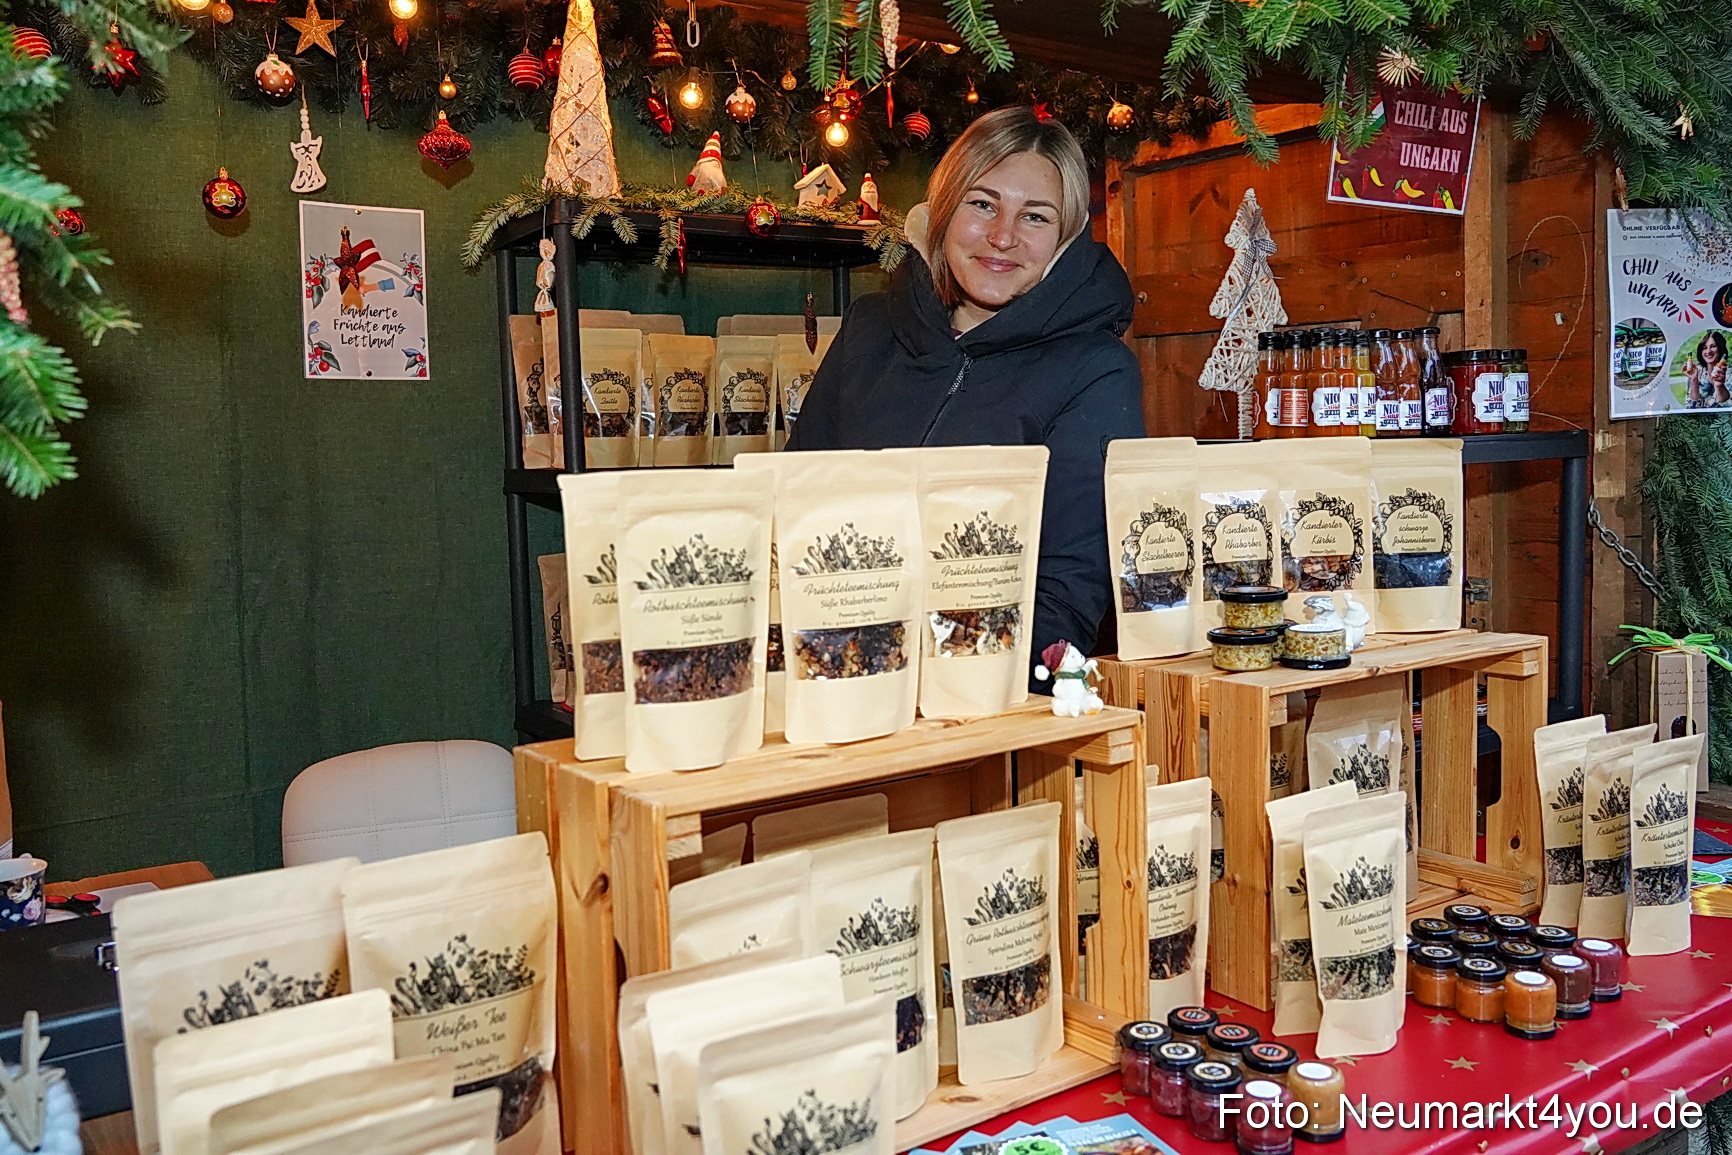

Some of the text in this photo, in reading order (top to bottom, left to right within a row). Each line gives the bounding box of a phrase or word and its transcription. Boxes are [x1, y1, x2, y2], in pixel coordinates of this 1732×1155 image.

[1394, 100, 1469, 135] CHILI AUS
[1400, 142, 1462, 174] UNGARN
[1623, 258, 1692, 292] CHILI AUS
[1628, 280, 1680, 318] UNGARN
[340, 303, 399, 320] Kandierte
[333, 319, 407, 335] Früchte aus
[341, 333, 396, 349] Lettland
[1397, 511, 1429, 521] Kandierte
[1221, 522, 1258, 535] Kandierte
[1300, 520, 1343, 531] Kandierter
[1398, 524, 1430, 533] schwarze
[1145, 534, 1177, 546] Kandierte
[1224, 538, 1262, 550] Rhabarber
[1311, 534, 1337, 545] Kürbis
[1141, 549, 1185, 562] Stachelbeeren
[941, 561, 1018, 577] Früchteteemischung
[803, 577, 900, 596] Früchteteemischung
[642, 592, 748, 613] Rotbuschteemischung
[820, 597, 838, 610] Süße
[426, 1007, 507, 1040] Weißer Tee
[475, 1037, 490, 1048] Mu
